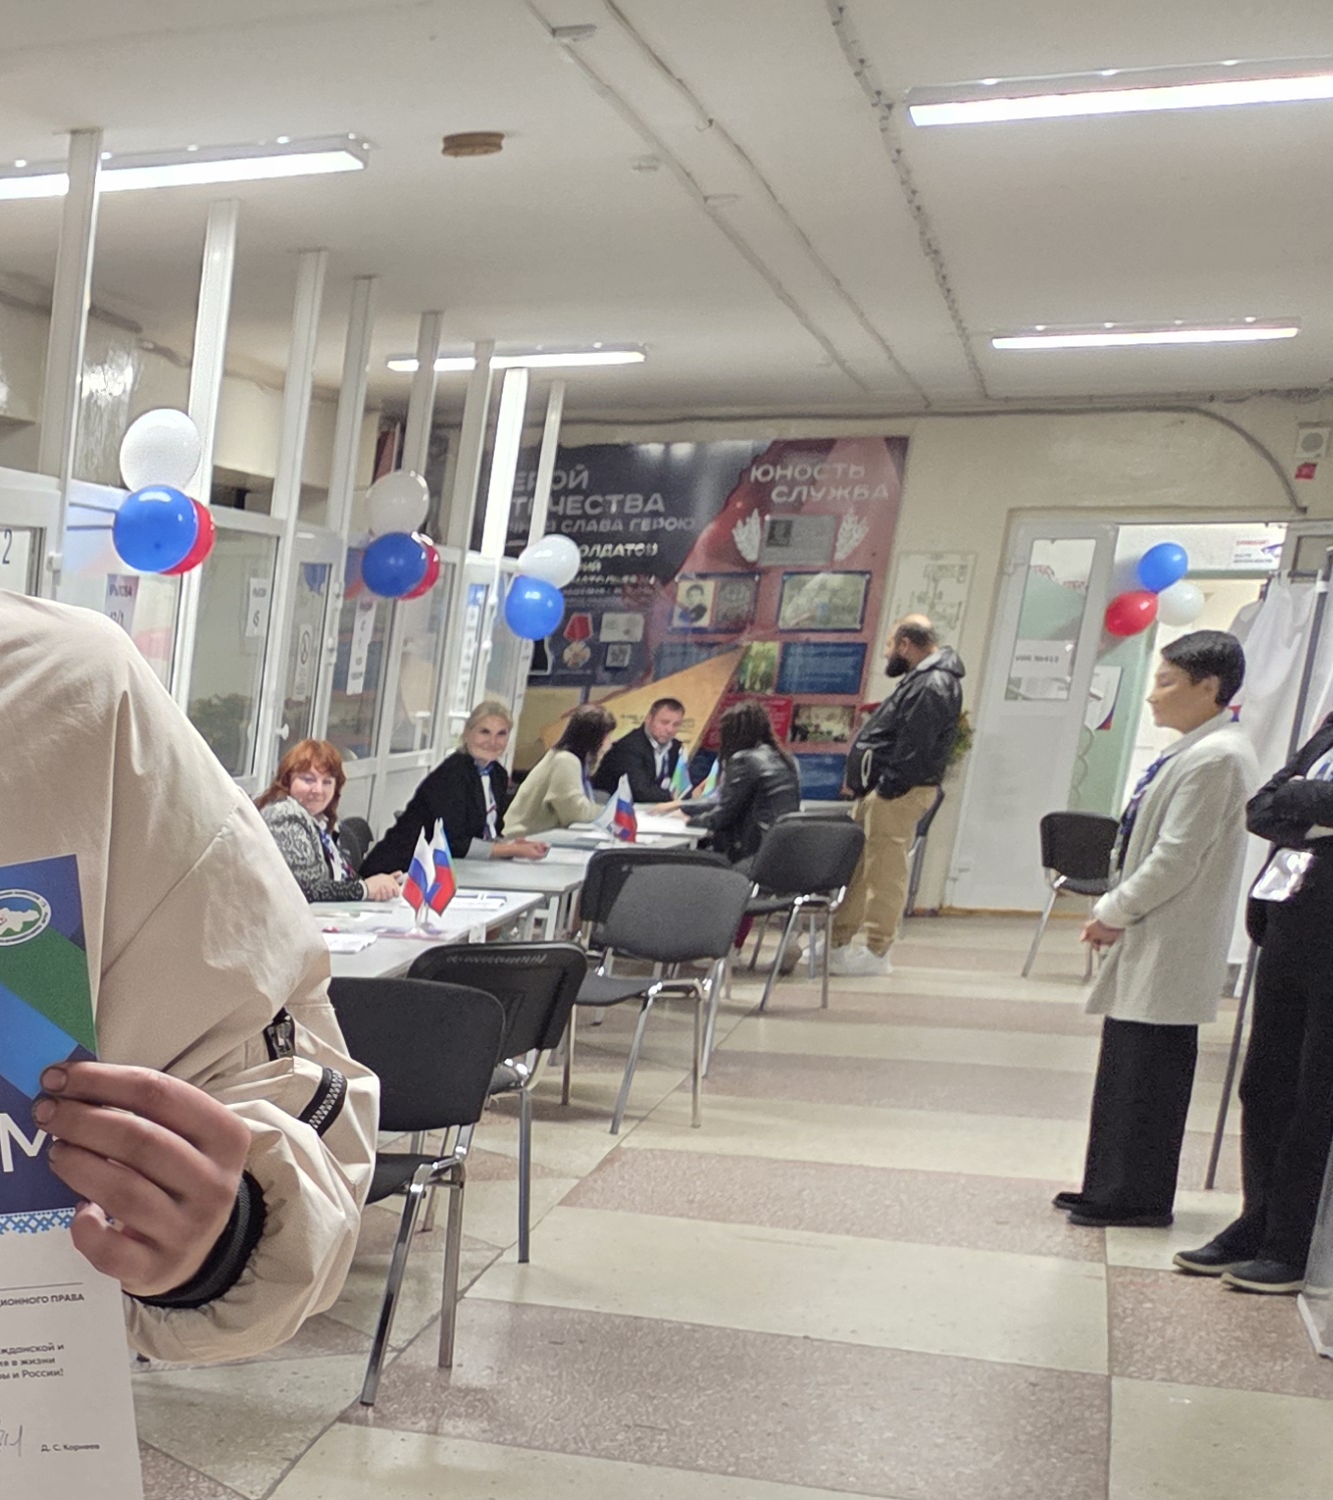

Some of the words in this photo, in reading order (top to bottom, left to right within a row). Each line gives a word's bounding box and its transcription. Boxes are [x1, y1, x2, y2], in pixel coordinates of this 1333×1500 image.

[750, 463, 865, 483] ЮНОСТЬ
[771, 484, 889, 504] СЛУЖБА
[513, 493, 666, 516] ТЧЕСТВА
[561, 517, 623, 533] СЛАВА
[579, 542, 658, 557] ОЛДАТОВ
[50, 1293, 84, 1303] ПРАВА
[20, 1356, 55, 1366] жизни
[12, 1371, 19, 1379] и
[21, 1368, 64, 1379] России!
